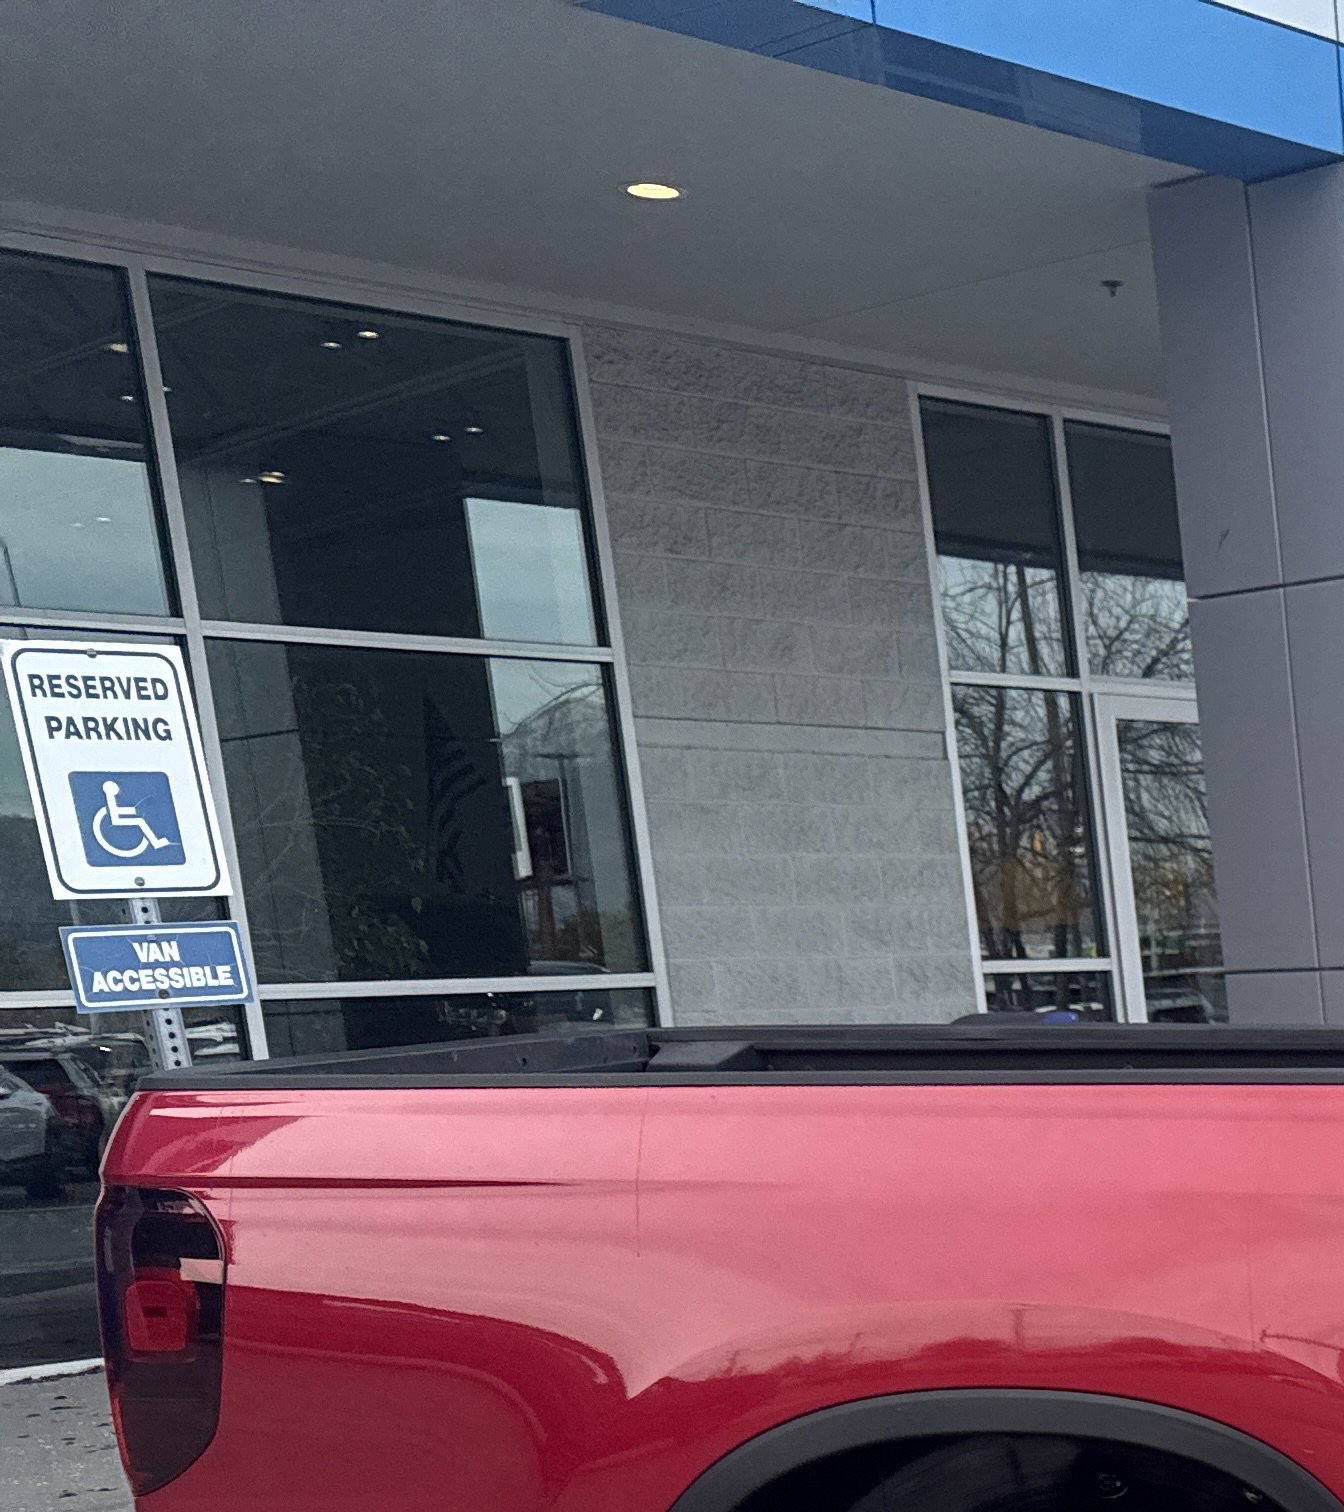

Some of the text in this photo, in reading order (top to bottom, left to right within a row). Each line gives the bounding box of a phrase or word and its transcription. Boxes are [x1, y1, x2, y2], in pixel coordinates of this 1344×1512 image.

[27, 674, 169, 701] RESERVED
[44, 716, 173, 741] PARKING
[132, 941, 181, 963] VAN
[92, 965, 234, 993] ACCESSIBLE
